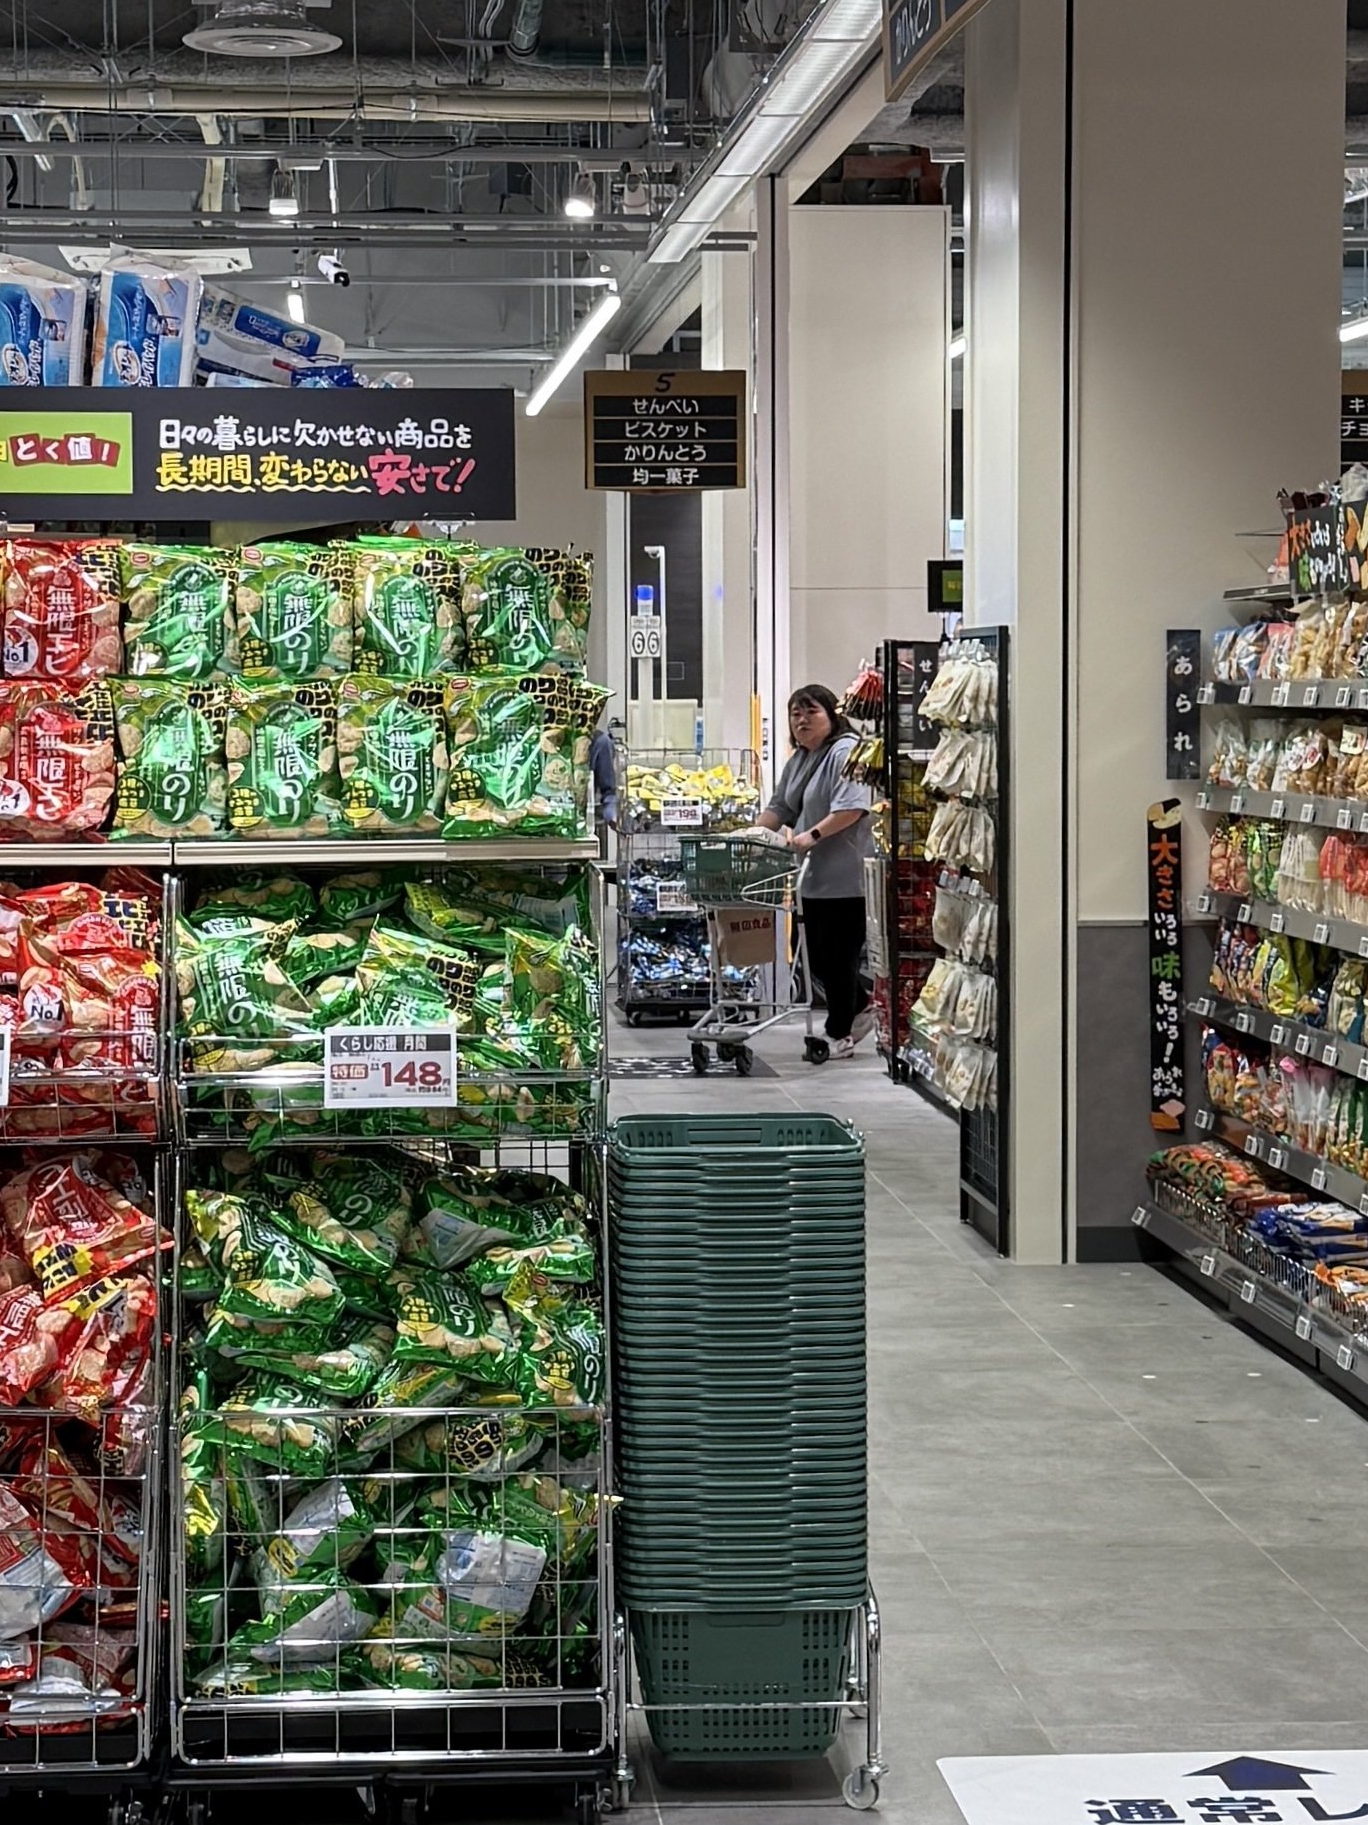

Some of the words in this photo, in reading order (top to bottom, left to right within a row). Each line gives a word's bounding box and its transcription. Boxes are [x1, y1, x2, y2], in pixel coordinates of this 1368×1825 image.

[654, 372, 675, 392] 5
[632, 398, 700, 415] せんべい
[159, 415, 472, 451] 日々の暮らしに欠かせない商品を
[625, 421, 707, 439] ビスケット
[624, 445, 708, 462] かりんとう
[155, 449, 477, 495] 長期間、変わらない安さで!
[632, 468, 700, 486] 均一菓子
[44, 587, 80, 675] 無限エビ
[281, 593, 315, 675] 無限のり
[1174, 657, 1194, 754] あられ
[34, 727, 63, 822] 無限エビ
[384, 727, 419, 823] 無限のり
[31, 1002, 64, 1021] No.1
[380, 1062, 442, 1087] 148
